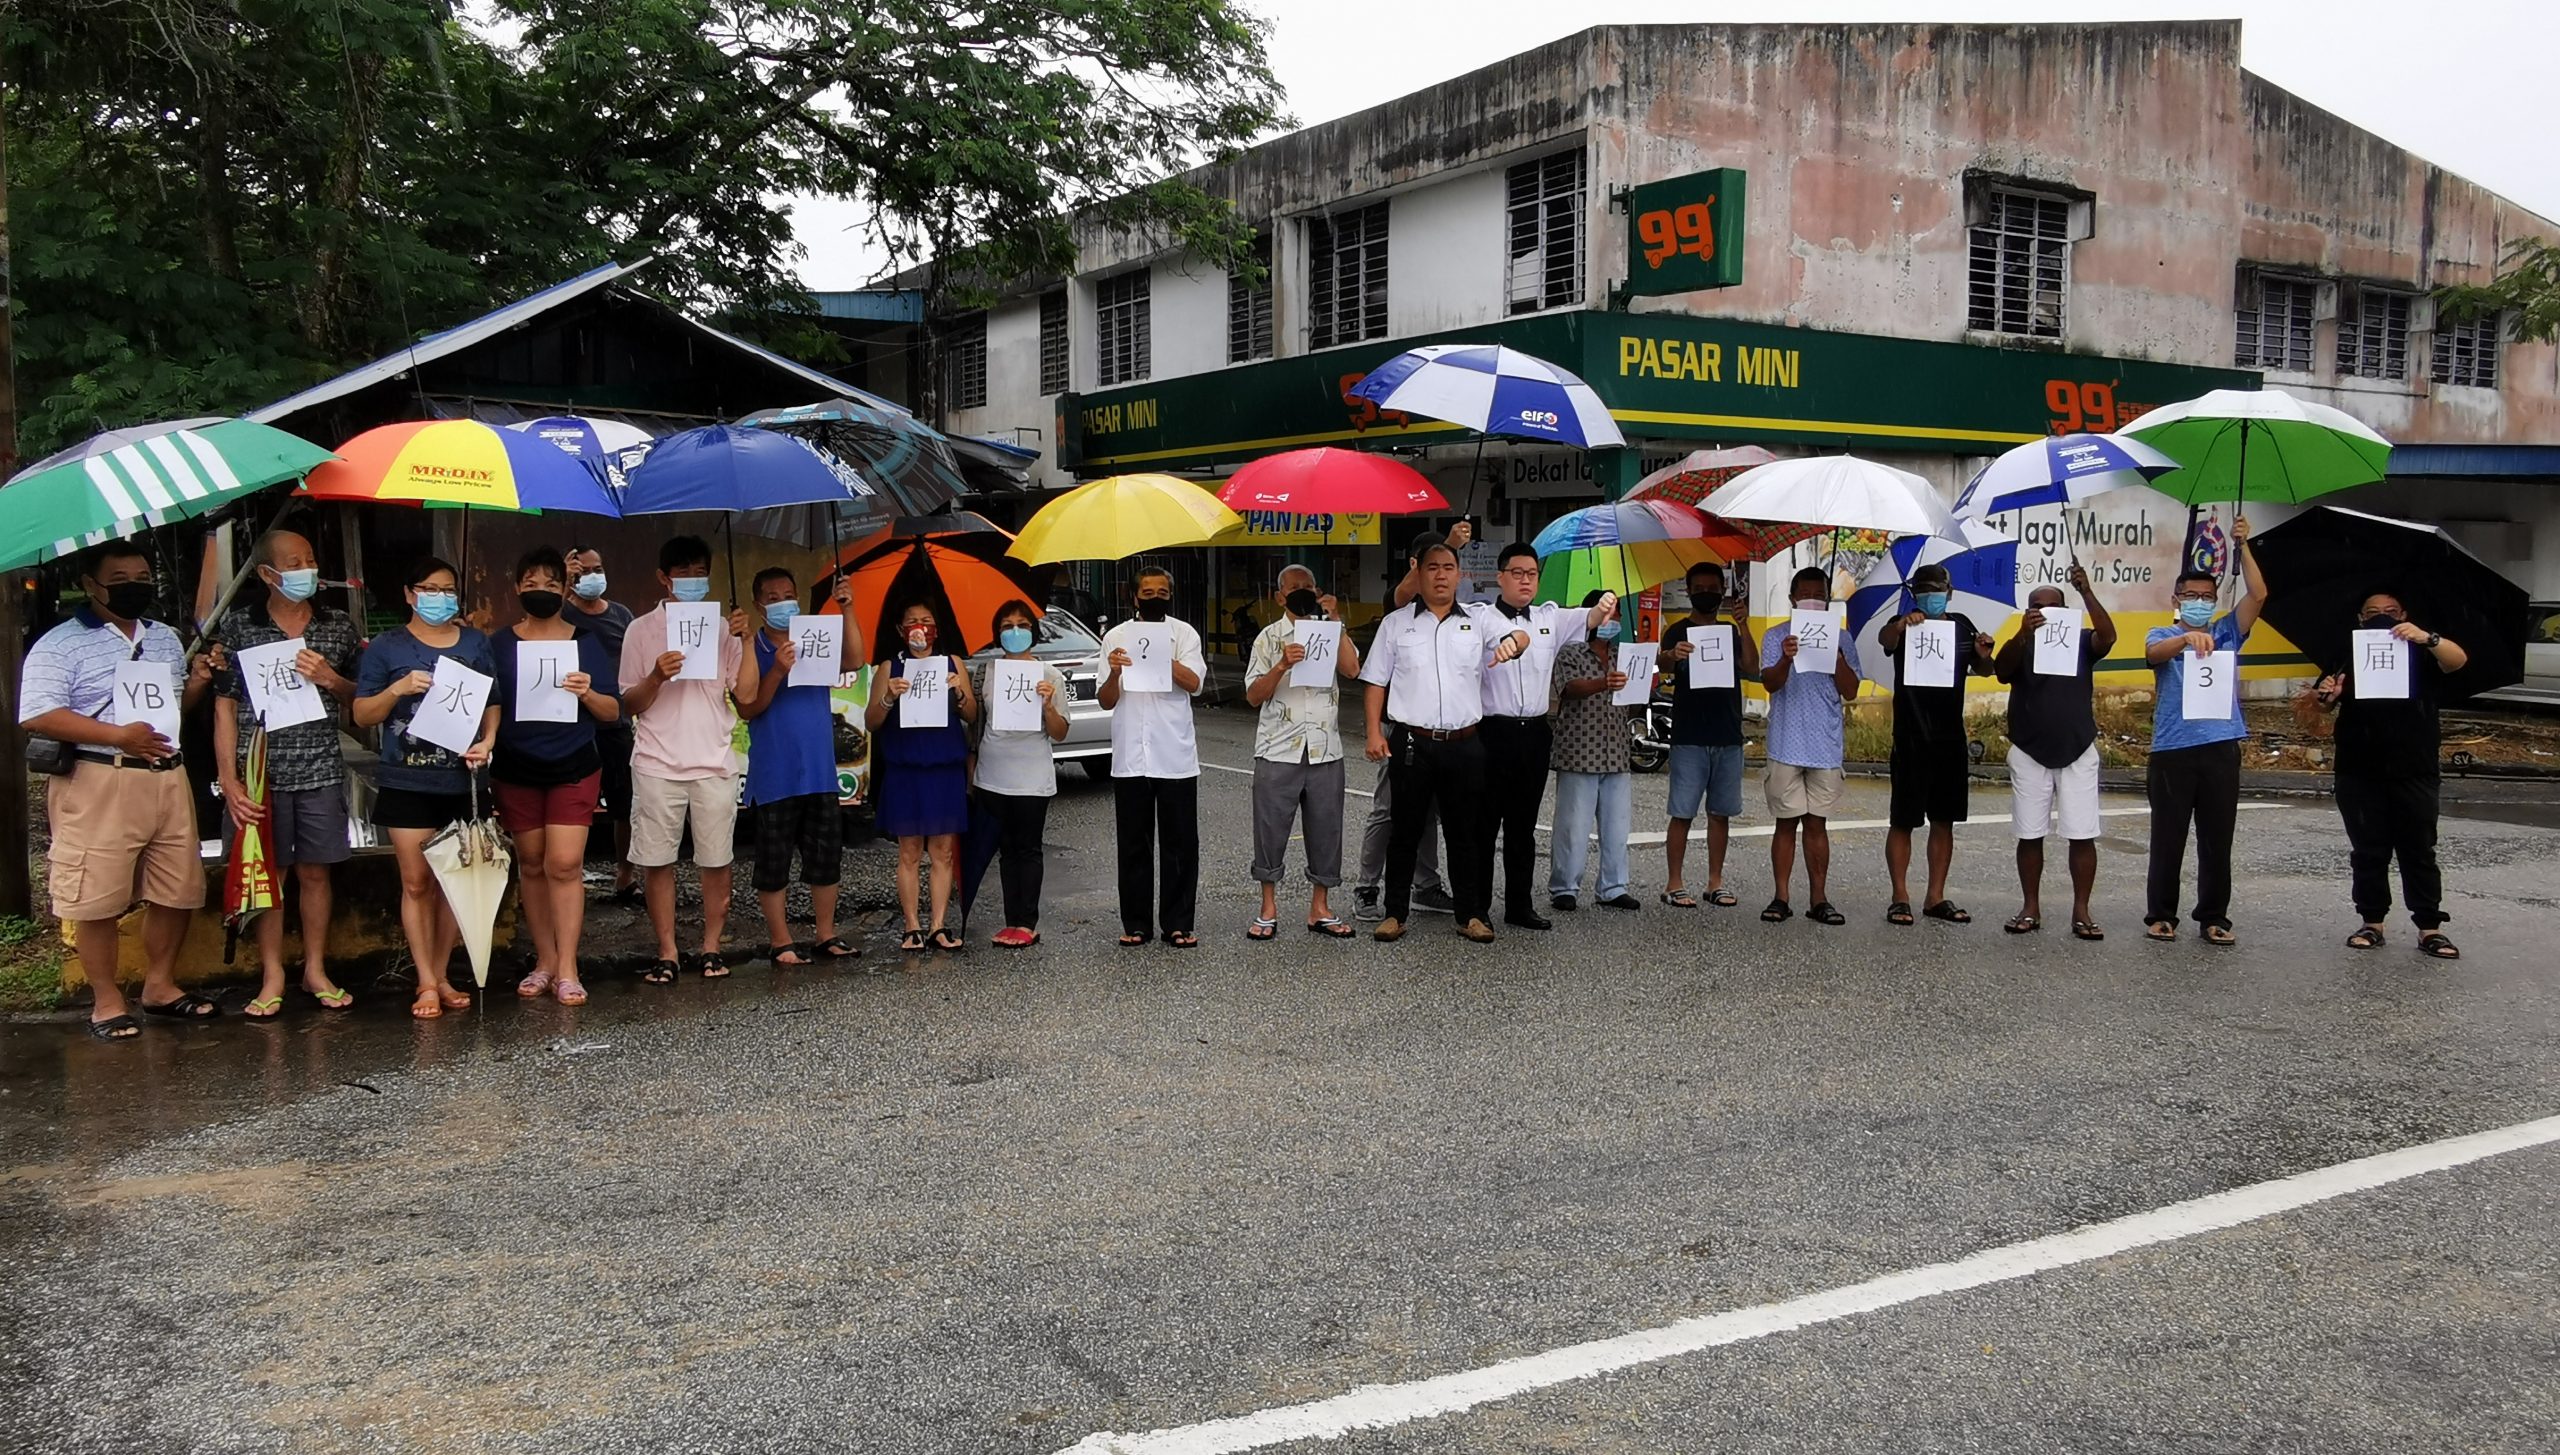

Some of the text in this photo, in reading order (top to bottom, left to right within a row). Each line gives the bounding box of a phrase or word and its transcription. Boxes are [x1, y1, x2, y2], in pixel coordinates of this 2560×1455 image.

[1638, 196, 1714, 269] 99
[1620, 336, 1799, 388] PASAR MINI
[1082, 404, 1121, 435] PASAR
[1127, 399, 1158, 430] MINI
[409, 477, 442, 485] Always
[463, 481, 492, 489] Prices
[1514, 454, 1570, 484] Dekat
[2075, 509, 2152, 546] Murah
[2111, 558, 2152, 583] Save
[679, 616, 709, 648] 时
[800, 628, 831, 659] 能
[1304, 633, 1331, 661] 你
[1799, 622, 1829, 650] 经
[1914, 631, 1944, 660] 执
[2044, 620, 2071, 648] 政
[1138, 637, 1150, 660] ?
[2363, 642, 2394, 672] 届
[258, 658, 303, 695] 淹
[1626, 655, 1649, 680] 们
[2199, 667, 2214, 688] 3
[123, 682, 165, 710] YB
[437, 680, 473, 716] 水
[909, 670, 938, 700] 解
[1005, 673, 1034, 703] 决
